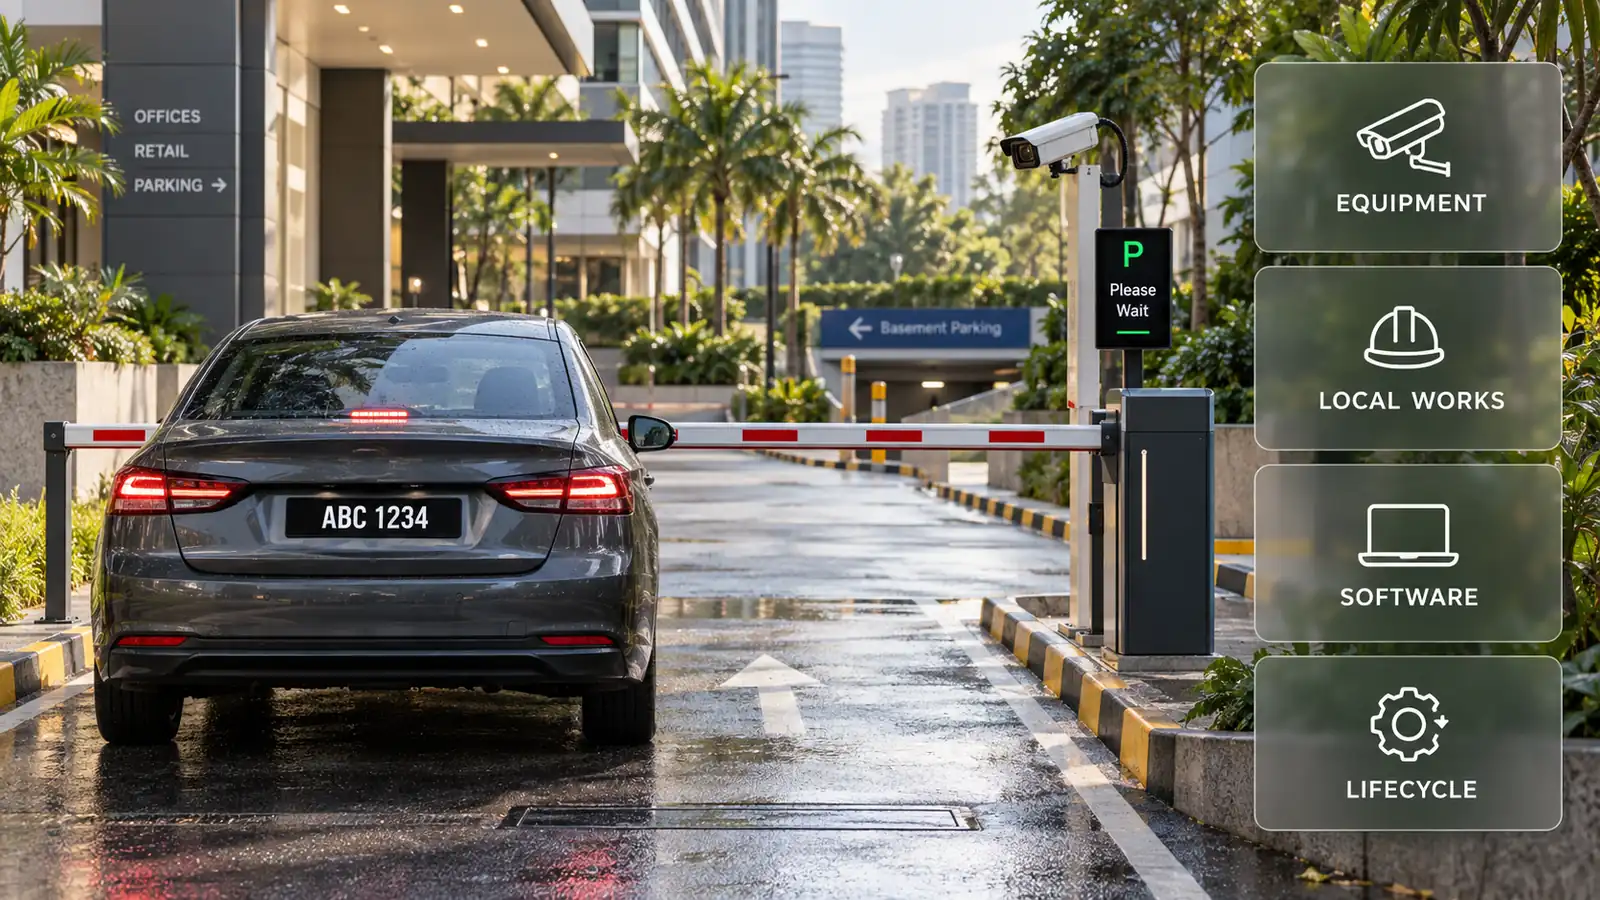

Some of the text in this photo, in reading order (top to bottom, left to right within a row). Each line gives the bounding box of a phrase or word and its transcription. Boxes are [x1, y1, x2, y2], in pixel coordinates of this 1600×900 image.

[134, 109, 201, 124] OFFICES
[134, 143, 189, 158] RETAIL
[134, 178, 203, 193] PARKING
[1123, 241, 1144, 268] P
[1110, 282, 1157, 297] Please
[1116, 303, 1149, 318] Wait
[880, 320, 1002, 338] Basement Parking
[321, 505, 429, 529] ABC 1234
